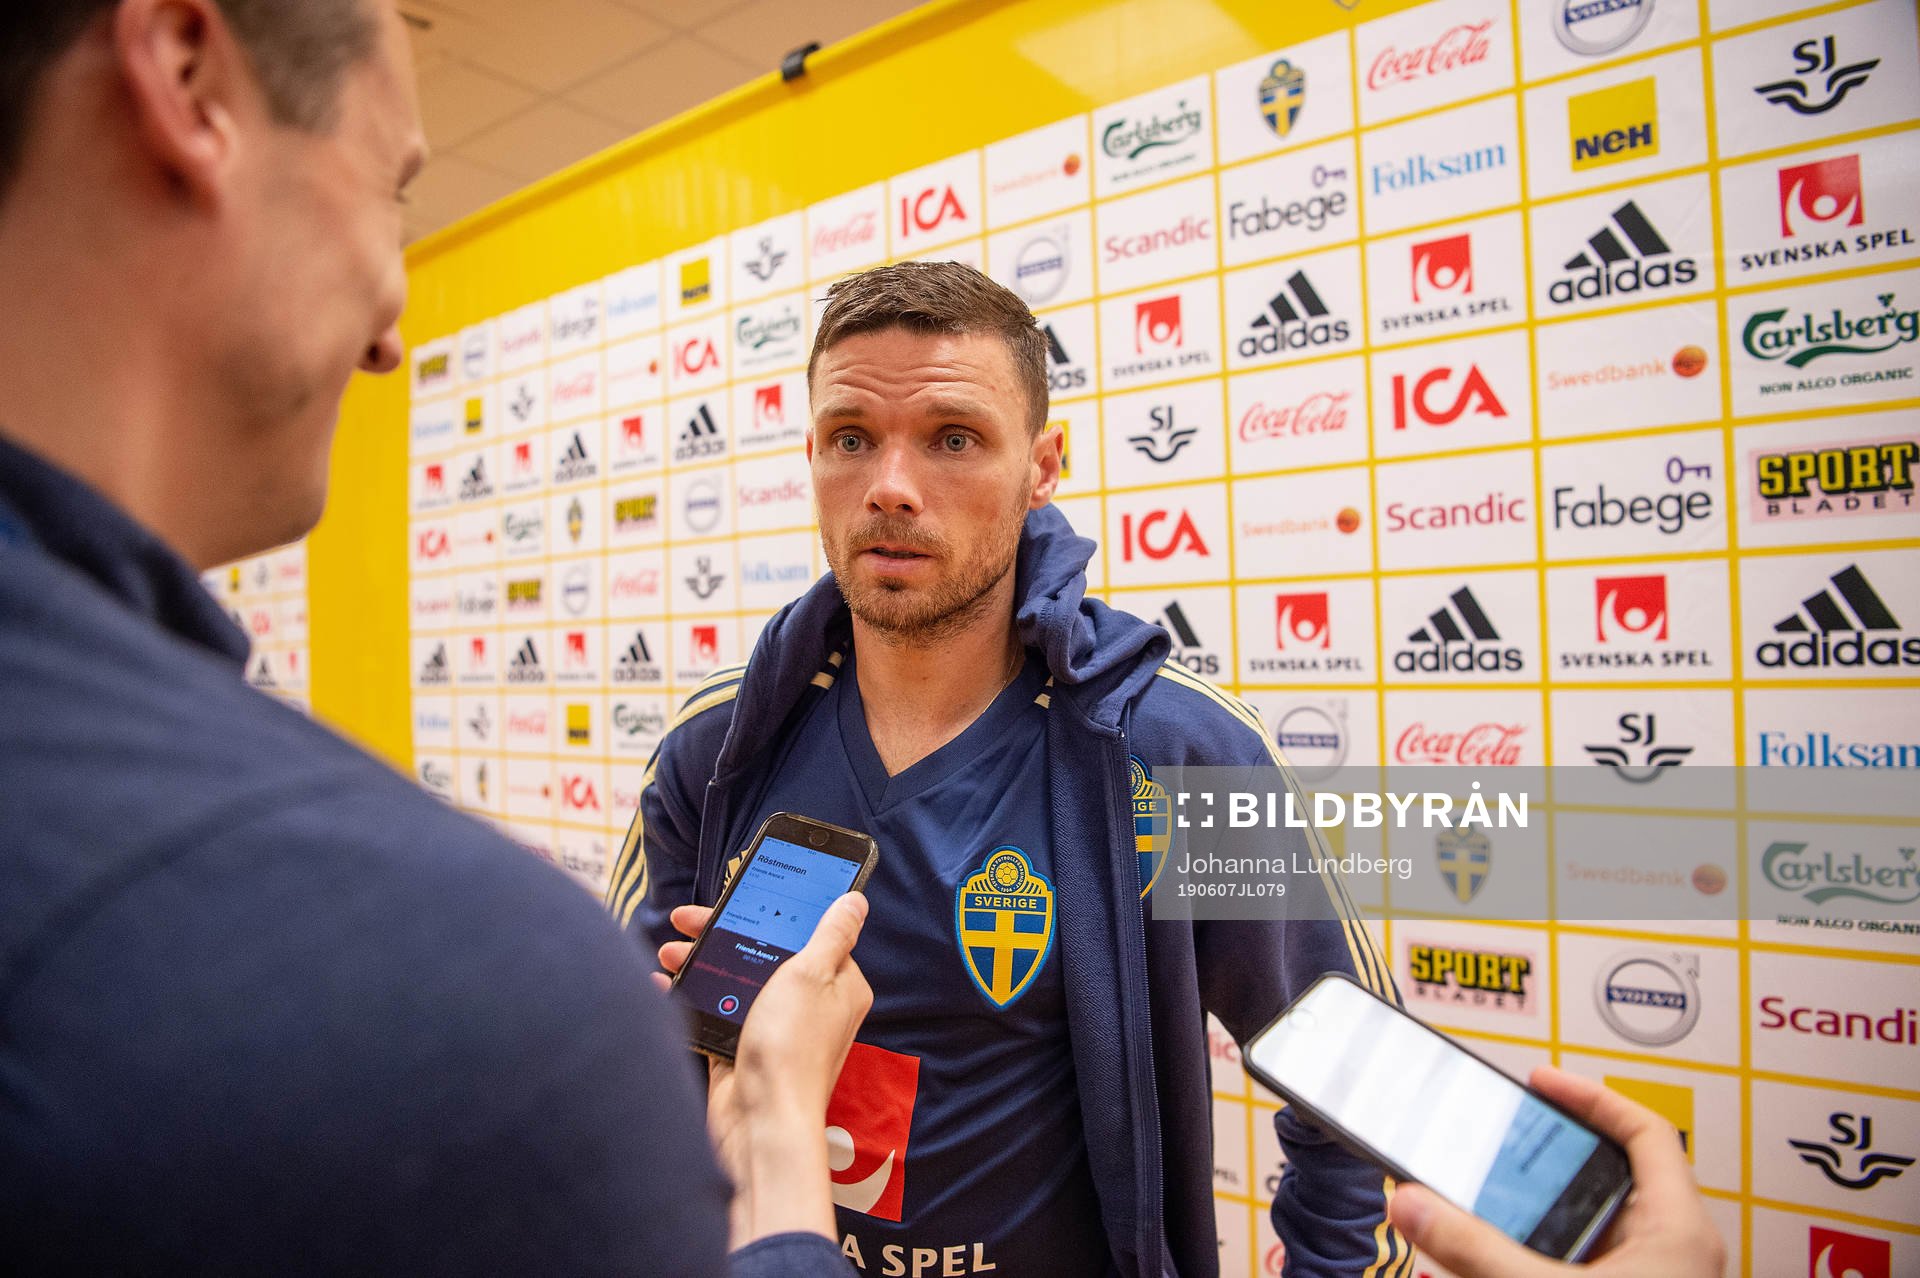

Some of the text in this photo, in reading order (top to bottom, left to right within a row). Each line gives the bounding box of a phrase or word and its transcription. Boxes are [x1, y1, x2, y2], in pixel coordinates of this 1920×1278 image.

[1792, 35, 1835, 74] SJ
[1372, 144, 1506, 195] Folksam
[901, 184, 967, 237] ICA
[1229, 191, 1346, 239] Fabege
[1105, 215, 1210, 263] Scandic
[1741, 229, 1915, 271] SVENSKA SPEL
[1549, 258, 1697, 304] adidas
[1381, 297, 1512, 331] SVENSKA SPEL
[1743, 293, 1920, 369] Carlsberg
[1238, 317, 1350, 357] adidas
[673, 336, 719, 379] ICA
[1547, 360, 1668, 391] Swedbank
[1392, 363, 1508, 430] ICA
[1760, 367, 1914, 395] NON ALCO ORGANIC
[1150, 405, 1175, 431] SJ
[1758, 441, 1920, 500] SPORT
[1387, 493, 1526, 532] Scandic
[1554, 485, 1712, 533] Fabege
[1767, 492, 1916, 516] BLADET
[1121, 509, 1210, 562] ICA
[1395, 641, 1523, 674] adidas
[1562, 650, 1712, 667] SVENSKA SPEL
[1757, 629, 1920, 668] adidas
[1619, 713, 1656, 746] SJ
[757, 854, 808, 876] Röstmemon
[1762, 842, 1920, 905] Carlsber
[974, 896, 1037, 909] SVERIGE
[1410, 944, 1530, 995] SPORT
[1760, 996, 1920, 1045] Scandi
[1828, 1112, 1872, 1150] SJ
[882, 1242, 996, 1278] SPEL
